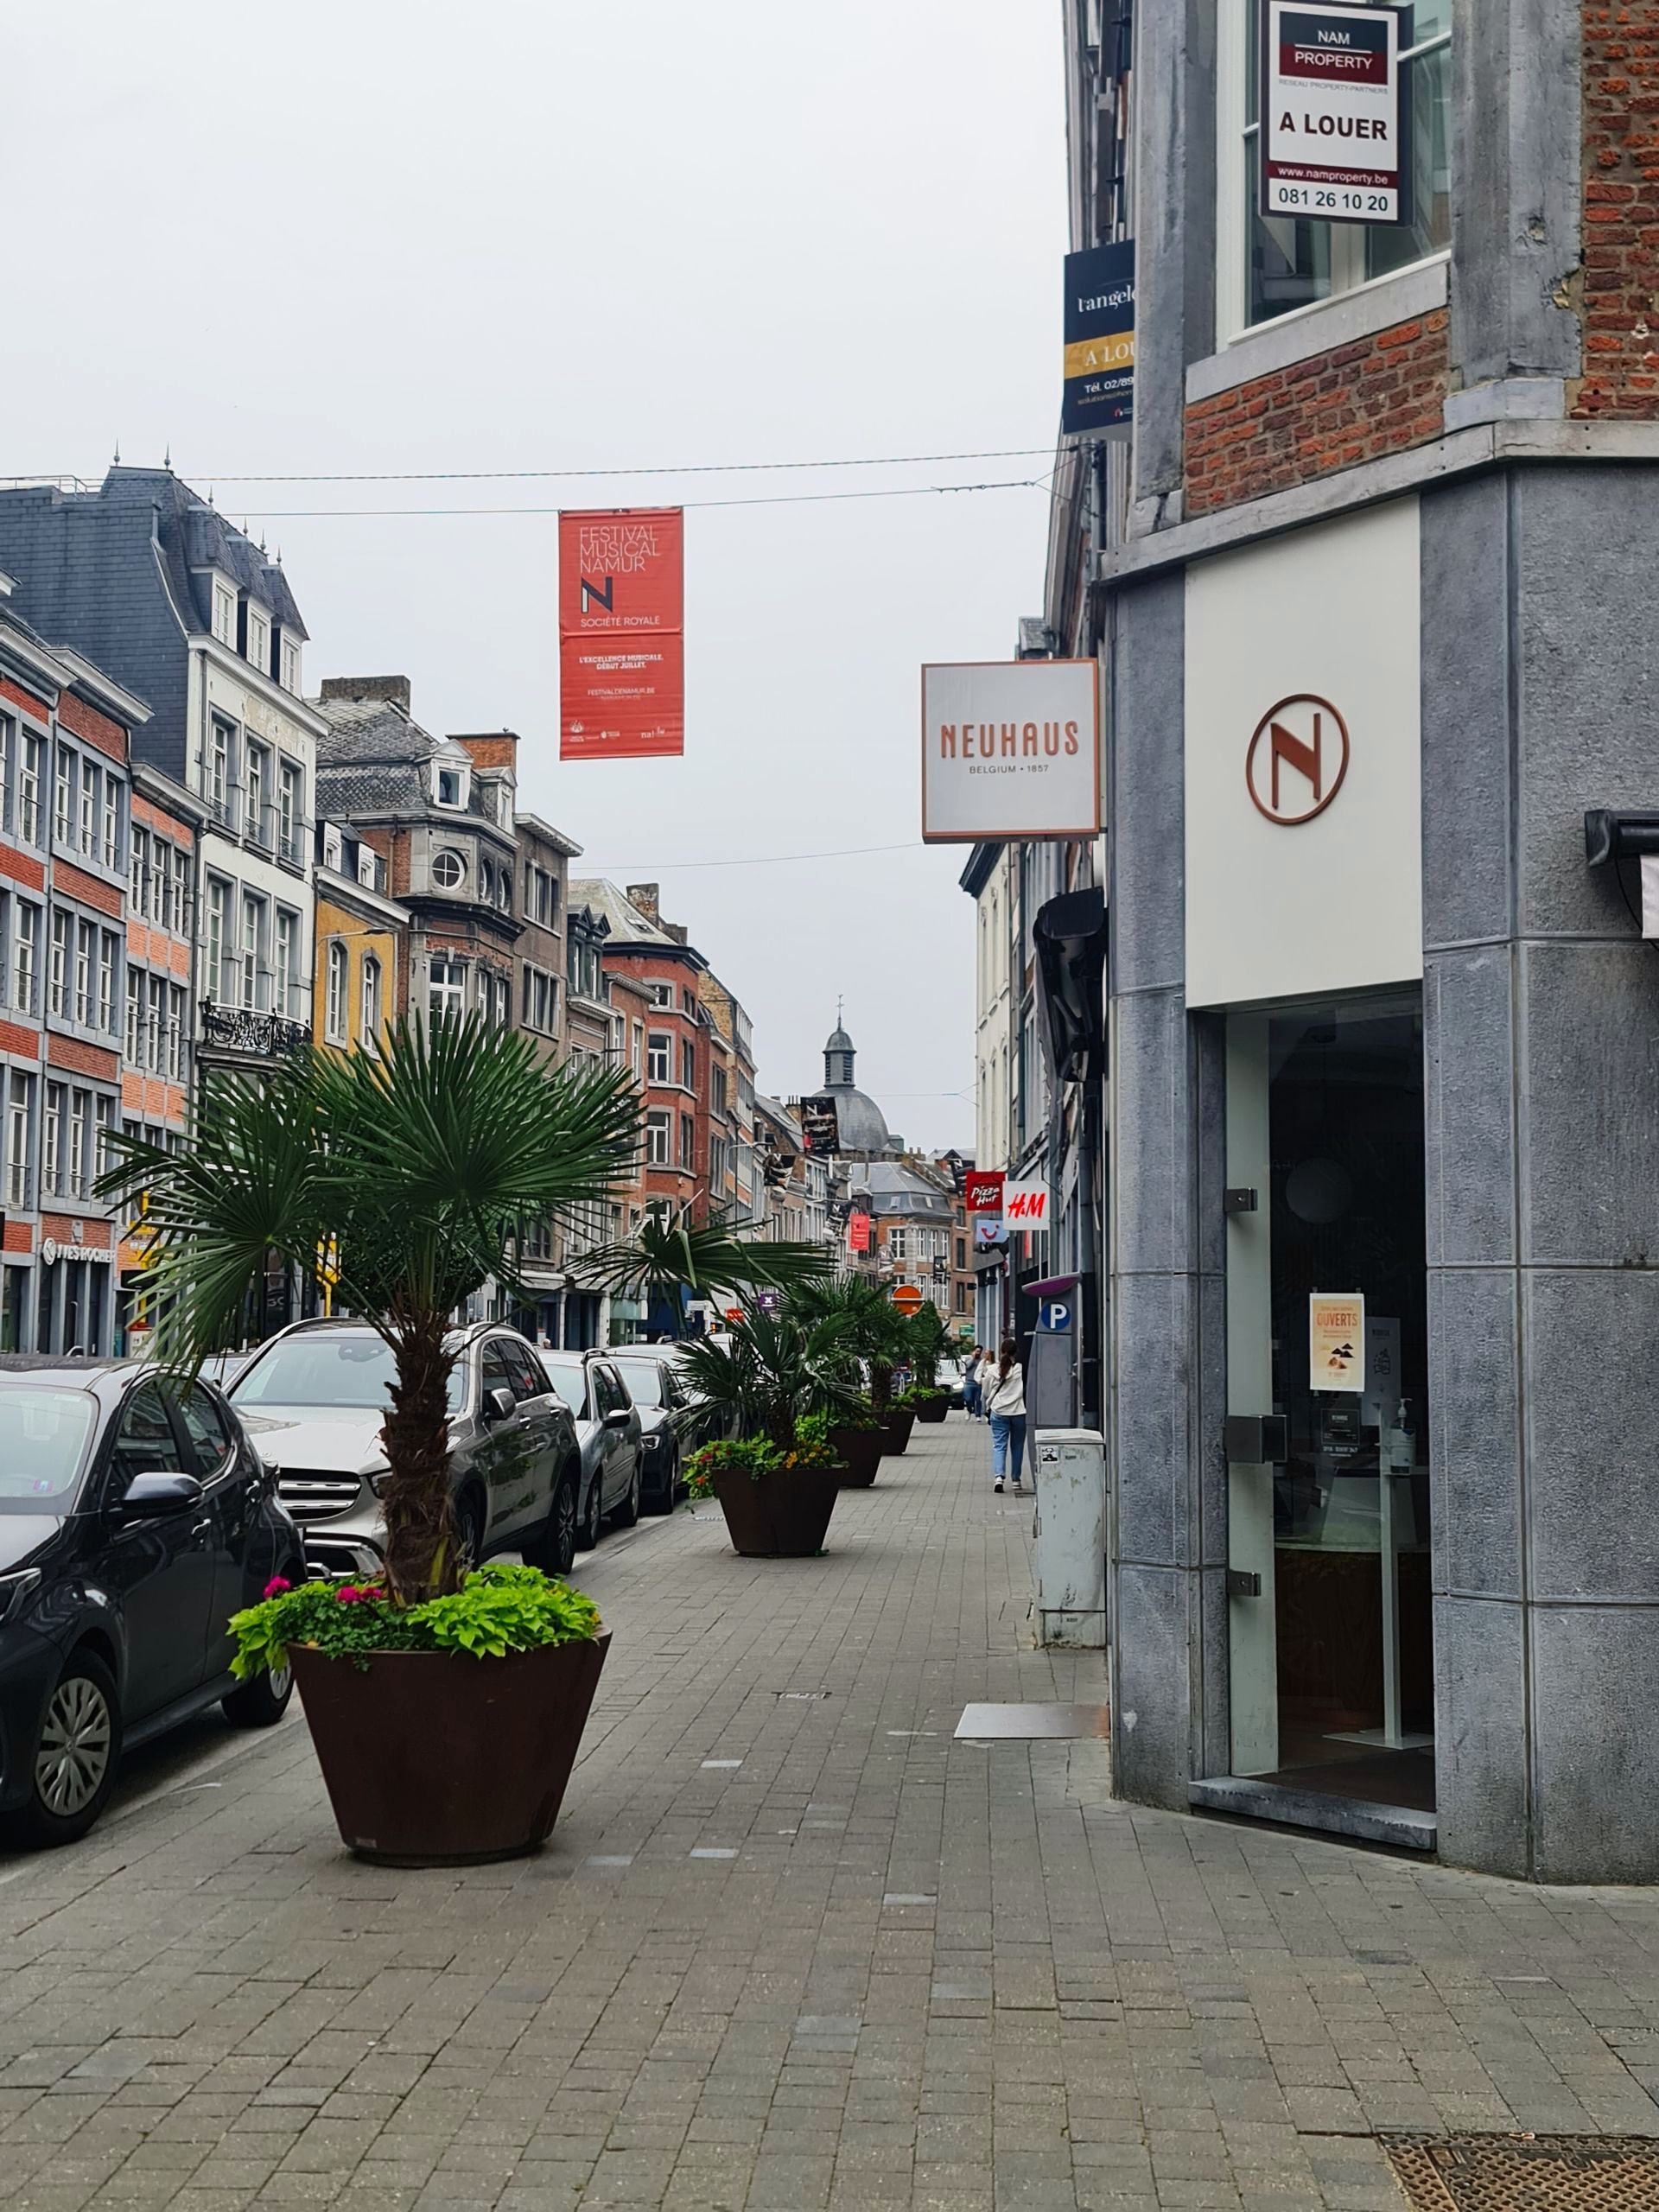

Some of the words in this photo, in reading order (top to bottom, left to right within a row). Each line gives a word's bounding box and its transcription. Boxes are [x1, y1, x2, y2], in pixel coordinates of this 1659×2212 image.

[1318, 29, 1350, 44] NAM
[1295, 51, 1372, 69] PROPERTY
[1279, 111, 1295, 132] A
[1305, 114, 1387, 140] LOUER
[1278, 166, 1389, 185] www.namproperty.be
[1279, 188, 1307, 205] 081
[1315, 191, 1336, 207] 26
[1343, 194, 1362, 209] 10
[1368, 195, 1388, 212] 20
[1085, 350, 1097, 367] A
[580, 525, 658, 543] FESTIVAL
[580, 541, 660, 558] MUSICAL
[580, 556, 646, 574] NAMUR
[581, 576, 613, 613] N
[581, 616, 621, 627] SOCIÉTÉ
[623, 615, 660, 626] ROYALE
[941, 721, 1078, 759] NEUHAUS
[969, 766, 1016, 774] BELGIUM
[970, 1185, 1000, 1199] Pizza
[976, 1193, 999, 1206] Hut
[1007, 1193, 1046, 1218] H&M
[1050, 1304, 1067, 1329] P
[1316, 1313, 1358, 1327] OUVERTS
